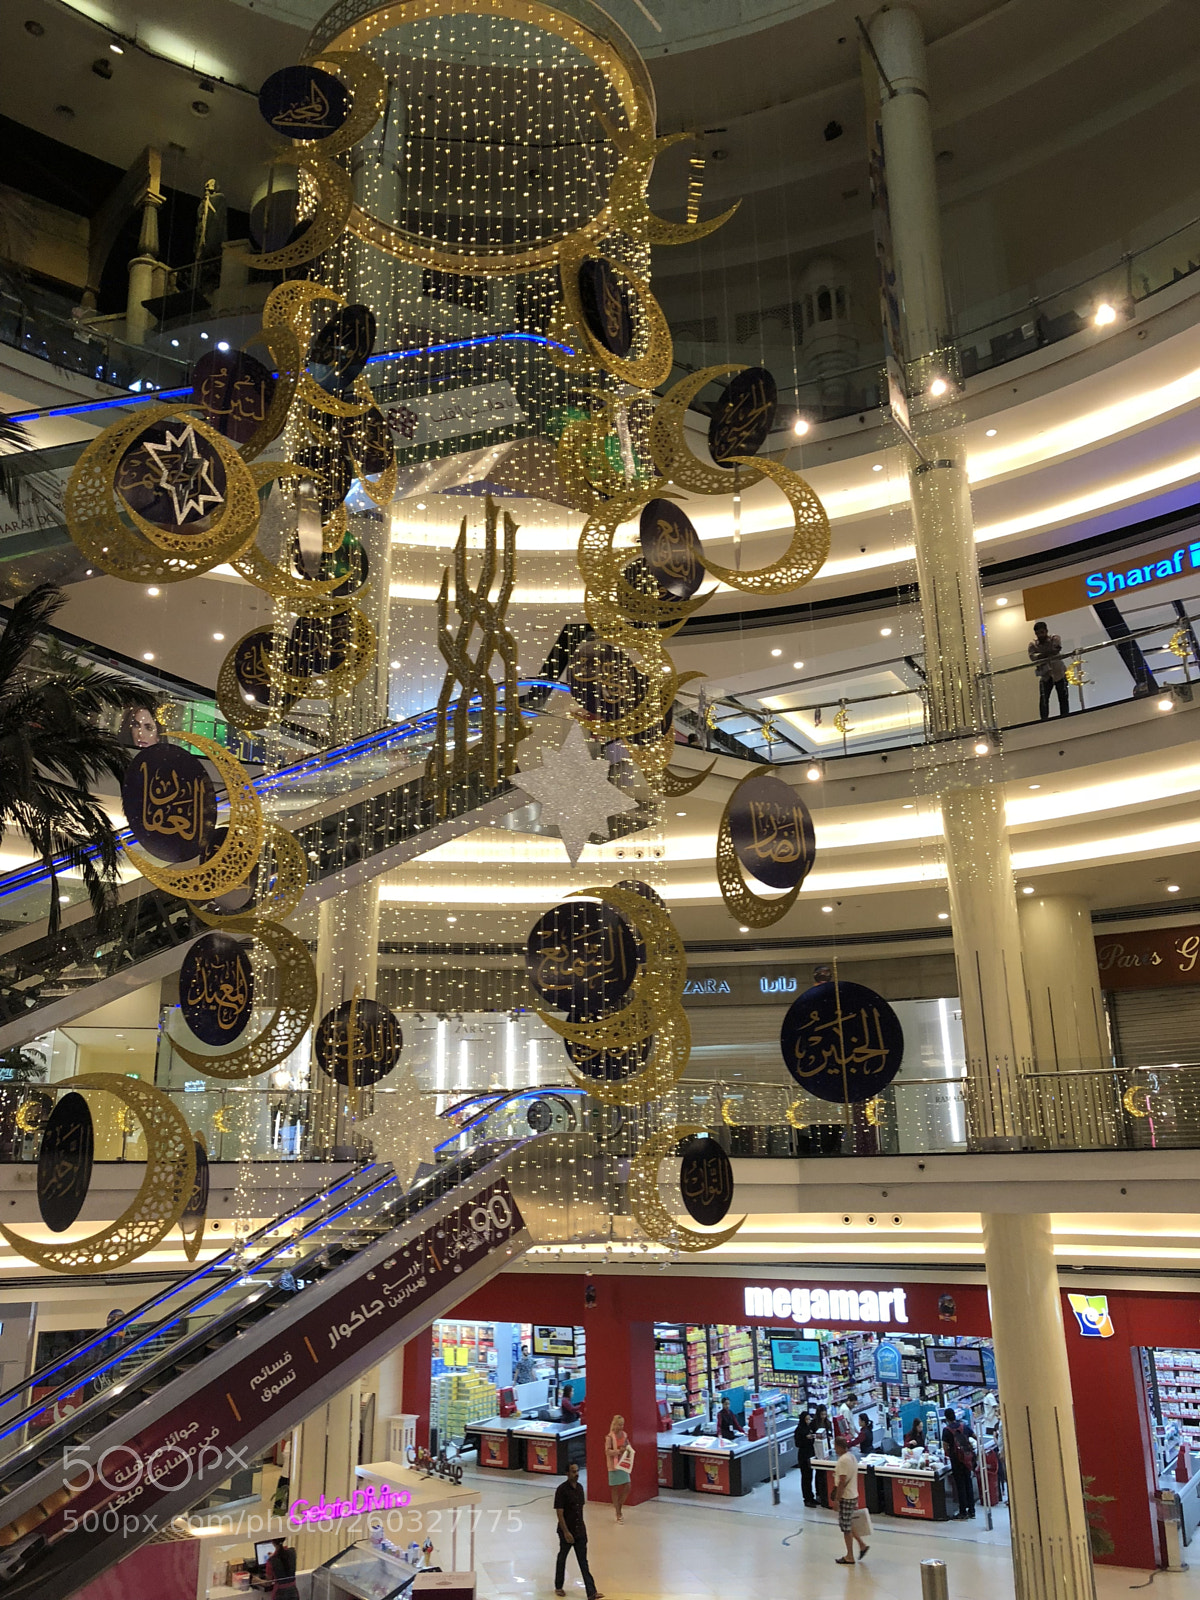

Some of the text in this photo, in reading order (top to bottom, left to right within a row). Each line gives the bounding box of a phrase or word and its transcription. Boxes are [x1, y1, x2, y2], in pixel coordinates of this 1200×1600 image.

[1085, 549, 1186, 598] Sharaf
[1098, 942, 1163, 971] Paris
[682, 978, 731, 995] ZARA
[760, 976, 798, 993] زارا
[743, 1286, 910, 1324] megamart
[326, 1298, 386, 1350] جاكوار
[249, 1351, 293, 1391] قسائم
[260, 1368, 297, 1402] تسوق
[164, 1420, 200, 1453] جوائز
